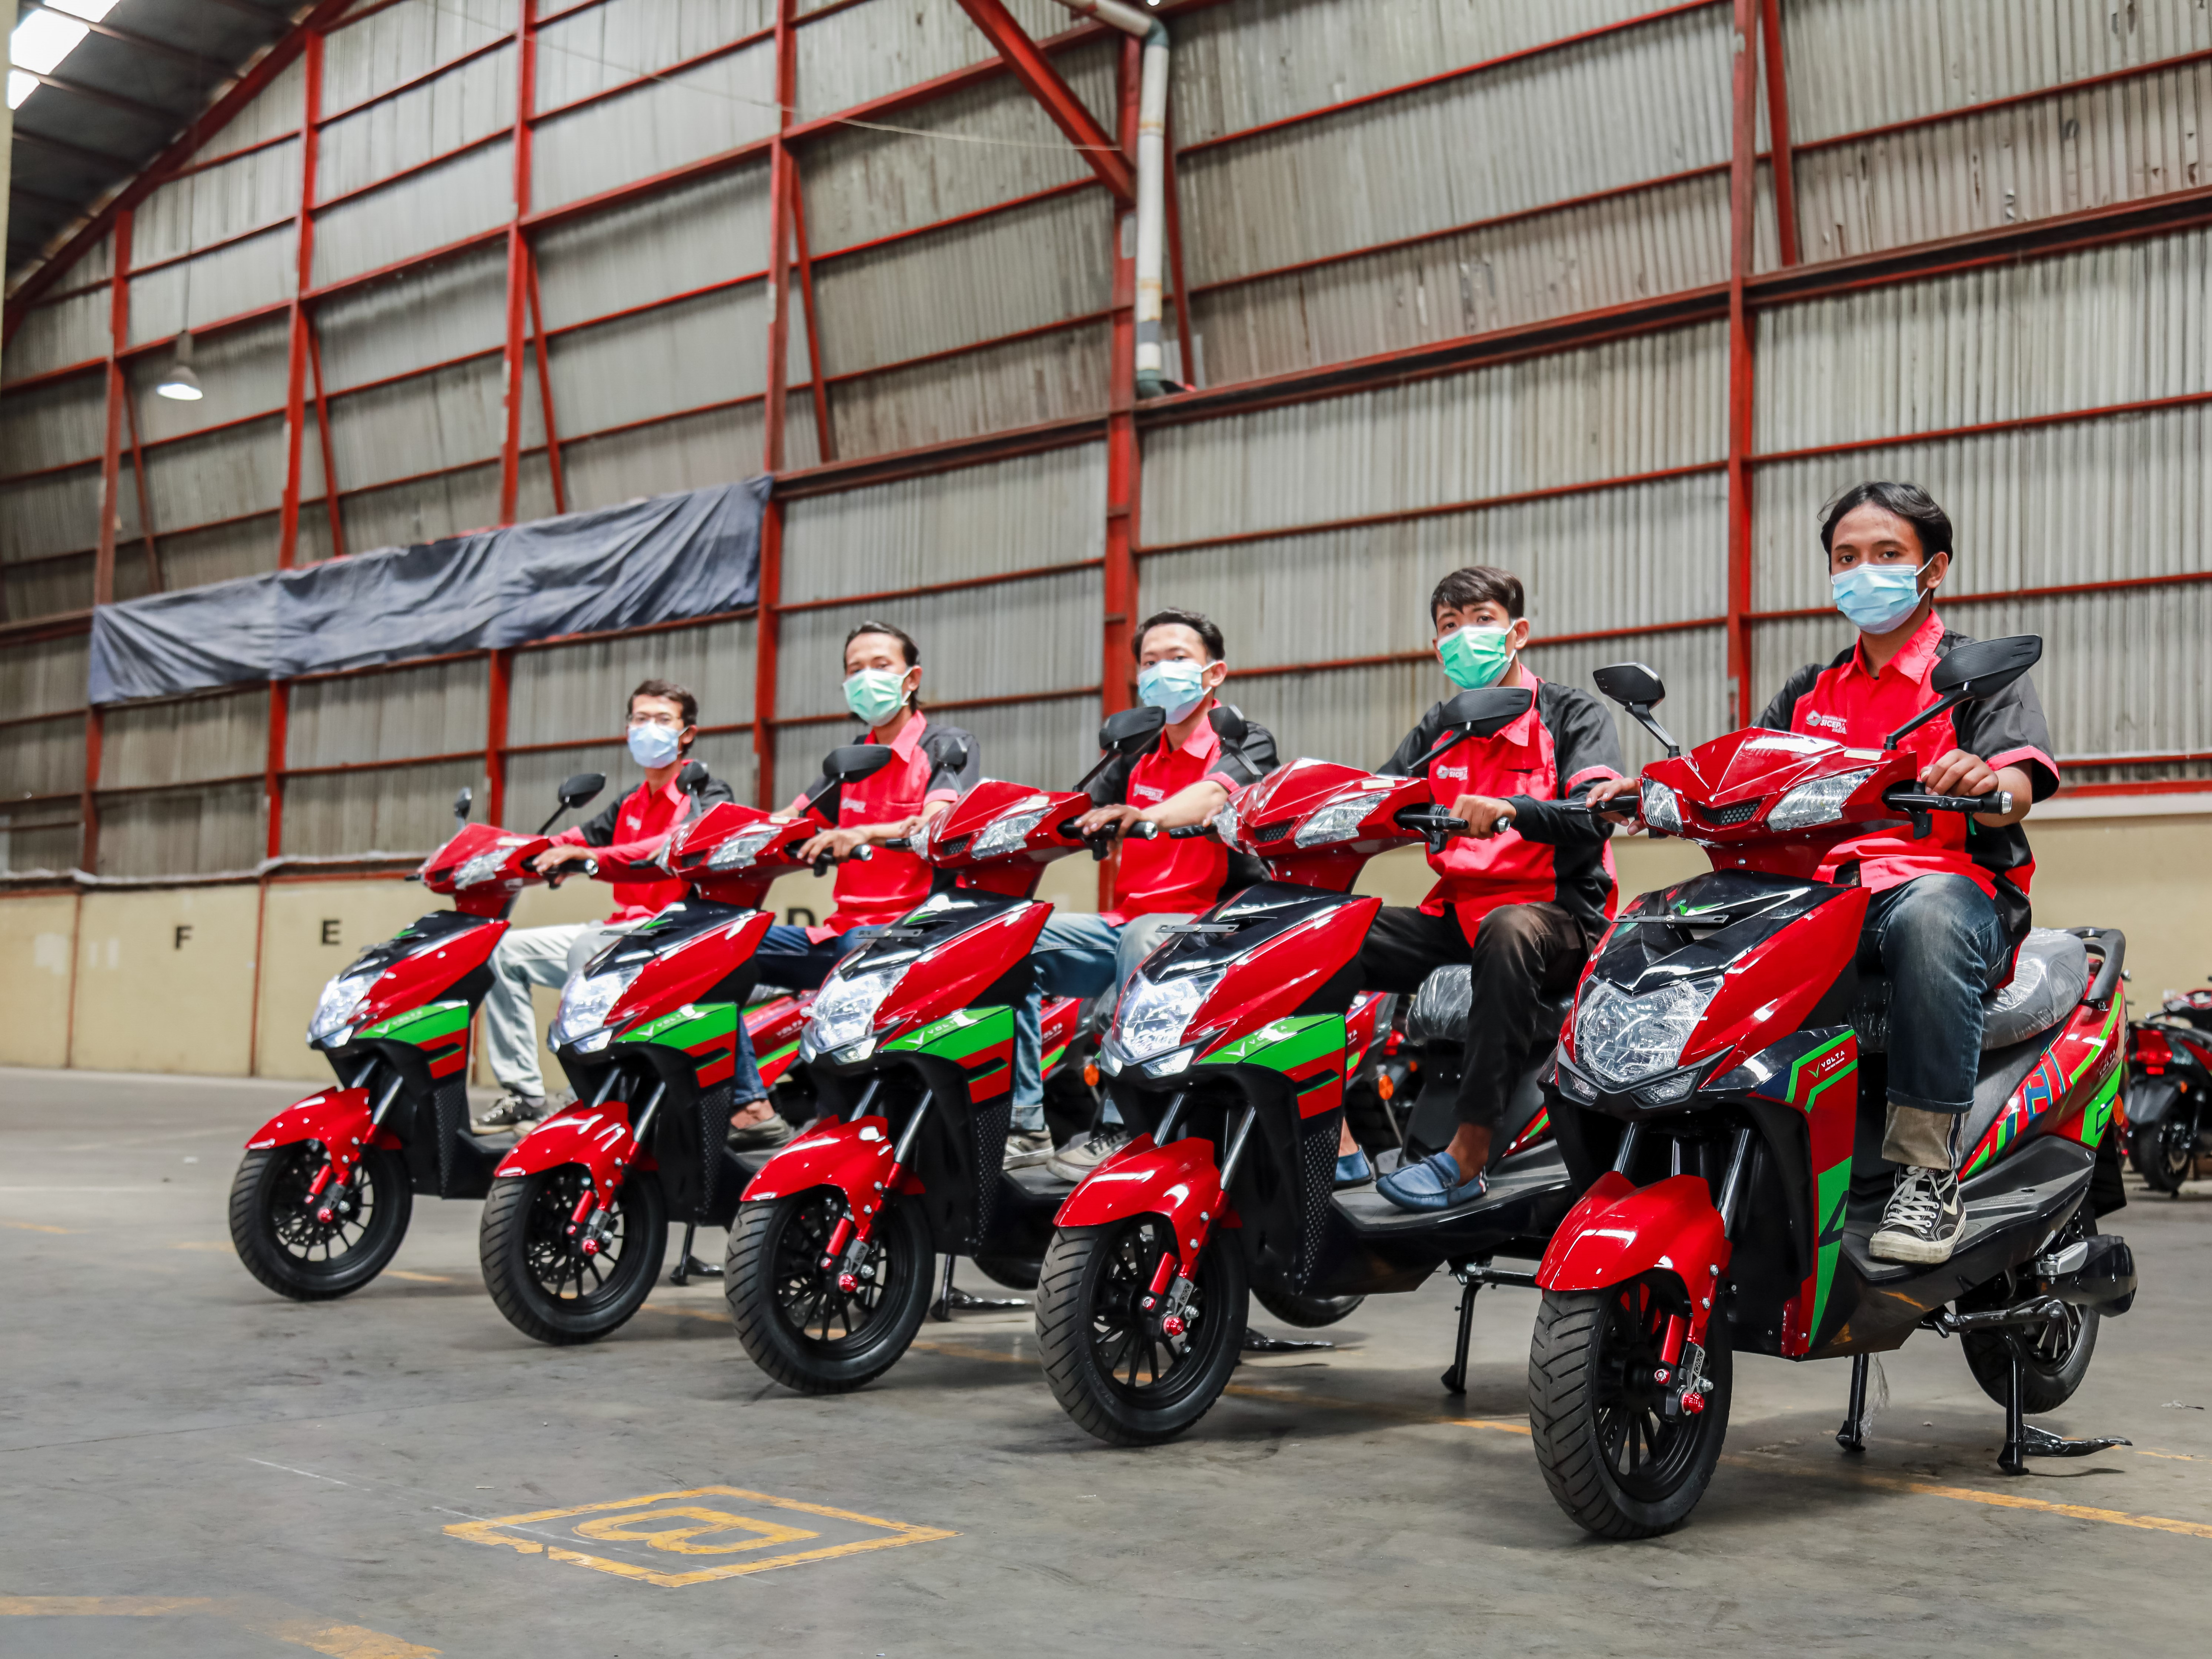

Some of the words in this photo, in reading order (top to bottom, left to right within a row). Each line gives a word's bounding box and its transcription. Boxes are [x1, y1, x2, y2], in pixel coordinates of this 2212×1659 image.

[1820, 720, 1847, 730] SICEPA
[176, 926, 192, 949] F
[323, 920, 340, 945] E
[927, 1020, 955, 1034] VOLT
[1249, 1025, 1287, 1044] VOA
[1821, 1050, 1845, 1068] VOLTA
[2099, 1049, 2115, 1075] VOLTA
